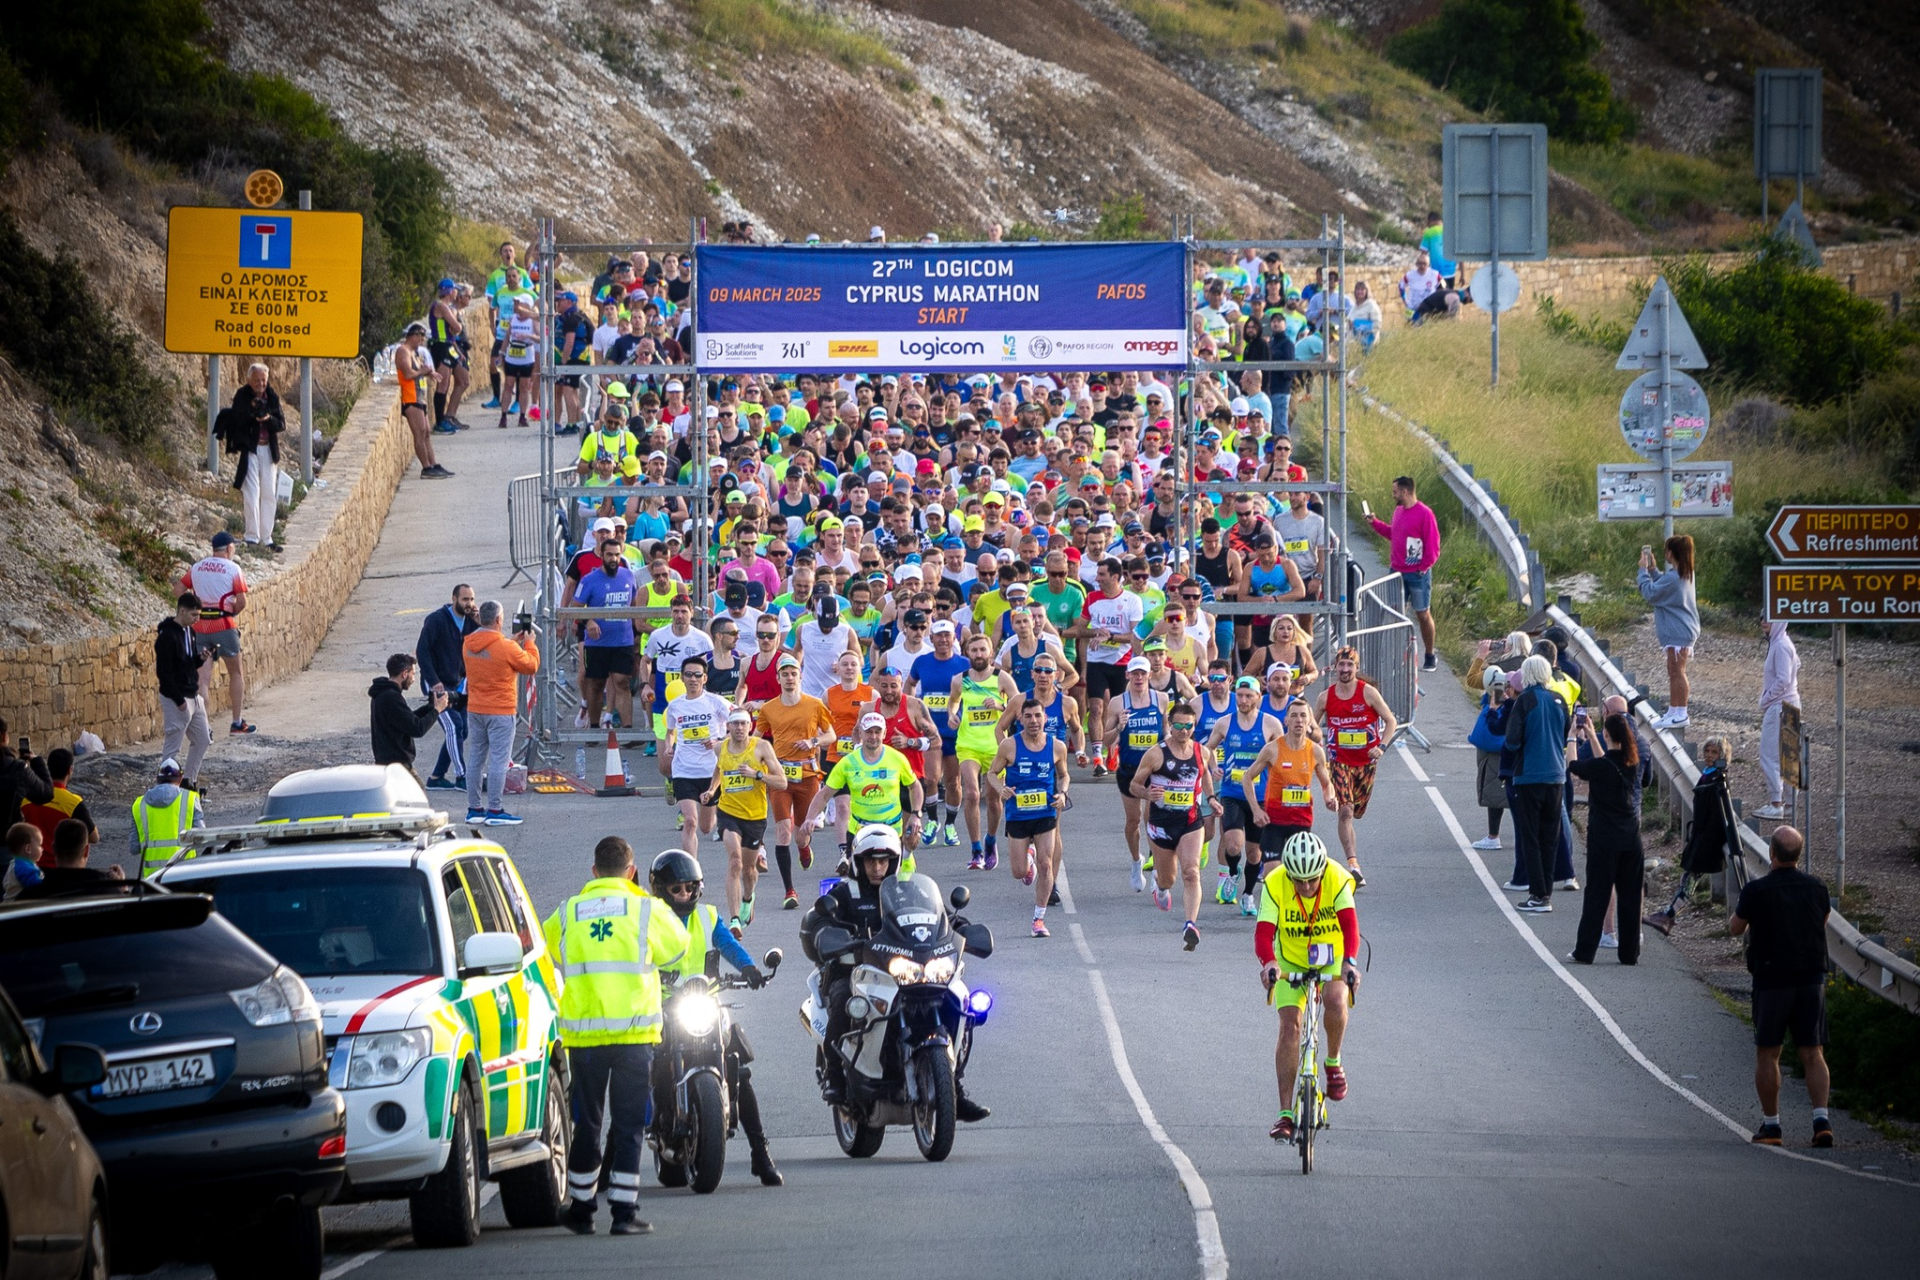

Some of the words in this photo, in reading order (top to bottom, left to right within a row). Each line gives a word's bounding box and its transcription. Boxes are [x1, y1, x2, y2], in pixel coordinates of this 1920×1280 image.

[924, 259, 1013, 278] LOGICOM
[221, 272, 232, 285] Ο
[240, 273, 308, 288] ΔΡΟΜΟΣ
[200, 286, 242, 300] ΕΙΝΑΙ
[249, 288, 328, 303] ΚΛΕΙΣΤΟΣ
[709, 288, 729, 302] 09
[731, 288, 781, 302] MARCH
[785, 287, 821, 302] 2025
[846, 285, 923, 303] CYPRUS
[934, 284, 1039, 303] MARATHON
[1097, 283, 1146, 300] PAFOS
[230, 302, 249, 315] ΣΕ
[256, 303, 282, 316] 600
[286, 304, 298, 317] Μ
[917, 307, 969, 324] START
[215, 320, 254, 333] Road
[260, 321, 311, 335] closed
[229, 335, 242, 348] in
[248, 336, 275, 348] 600
[279, 338, 292, 349] m
[725, 342, 764, 351] Scaffolding
[1086, 342, 1114, 350] REGION
[1124, 340, 1178, 356] omega
[725, 349, 757, 357] Solutions
[836, 345, 871, 353] DHL
[1806, 513, 1909, 531] ΠΕΡΙΠΤΕΡΟ
[1806, 534, 1919, 551] Refreshment
[197, 566, 227, 574] RUNNERS
[1776, 574, 1846, 591] ΠΕΤΡΑ
[1852, 575, 1896, 591] ΤΟΥ
[1903, 574, 1920, 591] Ρ
[605, 591, 629, 603] ATHENS
[1776, 597, 1830, 614] Petra
[1838, 597, 1875, 614] Tou
[928, 696, 946, 706] 323
[682, 713, 712, 723] ENEOS
[973, 711, 992, 721] 557
[1128, 716, 1158, 728] ESTONIA
[692, 728, 698, 737] 5
[1350, 733, 1354, 742] 1
[1134, 735, 1152, 744] 186
[782, 766, 797, 776] 95
[728, 776, 747, 785] 247
[1023, 793, 1041, 804] 391
[1169, 792, 1190, 802] 452
[933, 943, 955, 956] POLICE
[812, 1018, 826, 1037] POLIC
[107, 1065, 148, 1093] MYP
[166, 1058, 206, 1083] 142
[241, 1080, 262, 1091] RX
